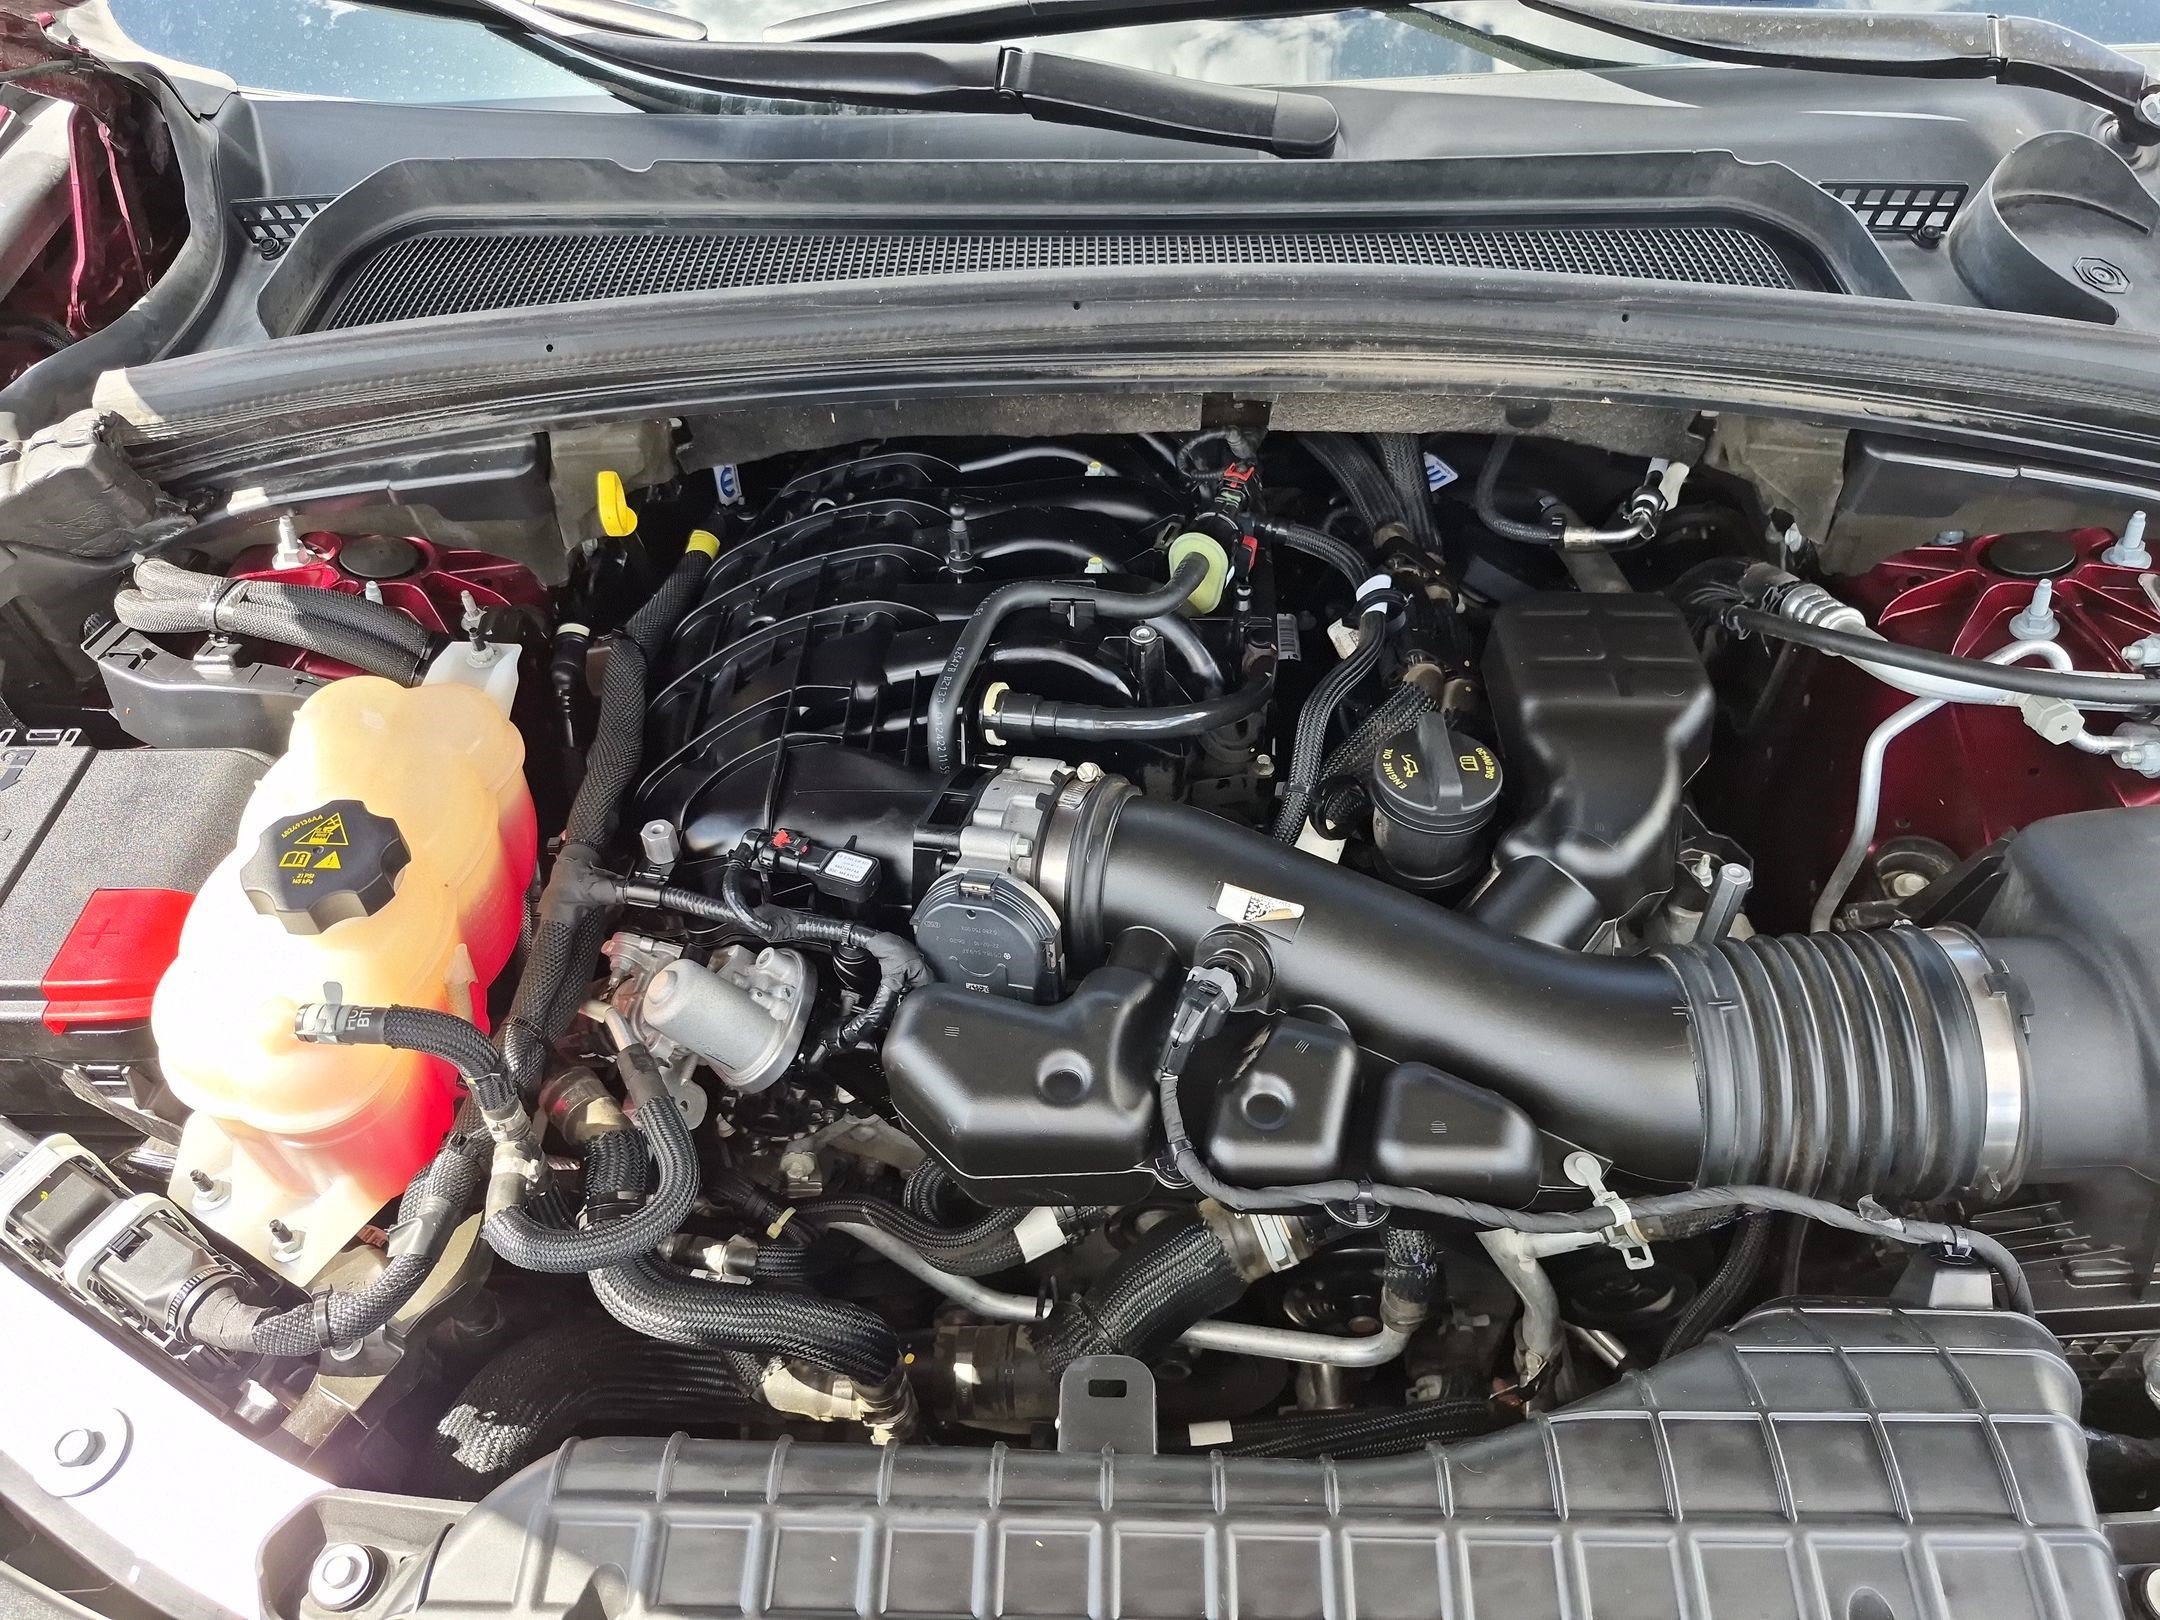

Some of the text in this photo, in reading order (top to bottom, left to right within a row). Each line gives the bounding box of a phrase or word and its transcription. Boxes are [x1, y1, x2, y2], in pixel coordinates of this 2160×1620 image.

[1382, 748, 1408, 790] ENGINE OIL
[1475, 747, 1495, 780] SAE 0W-20
